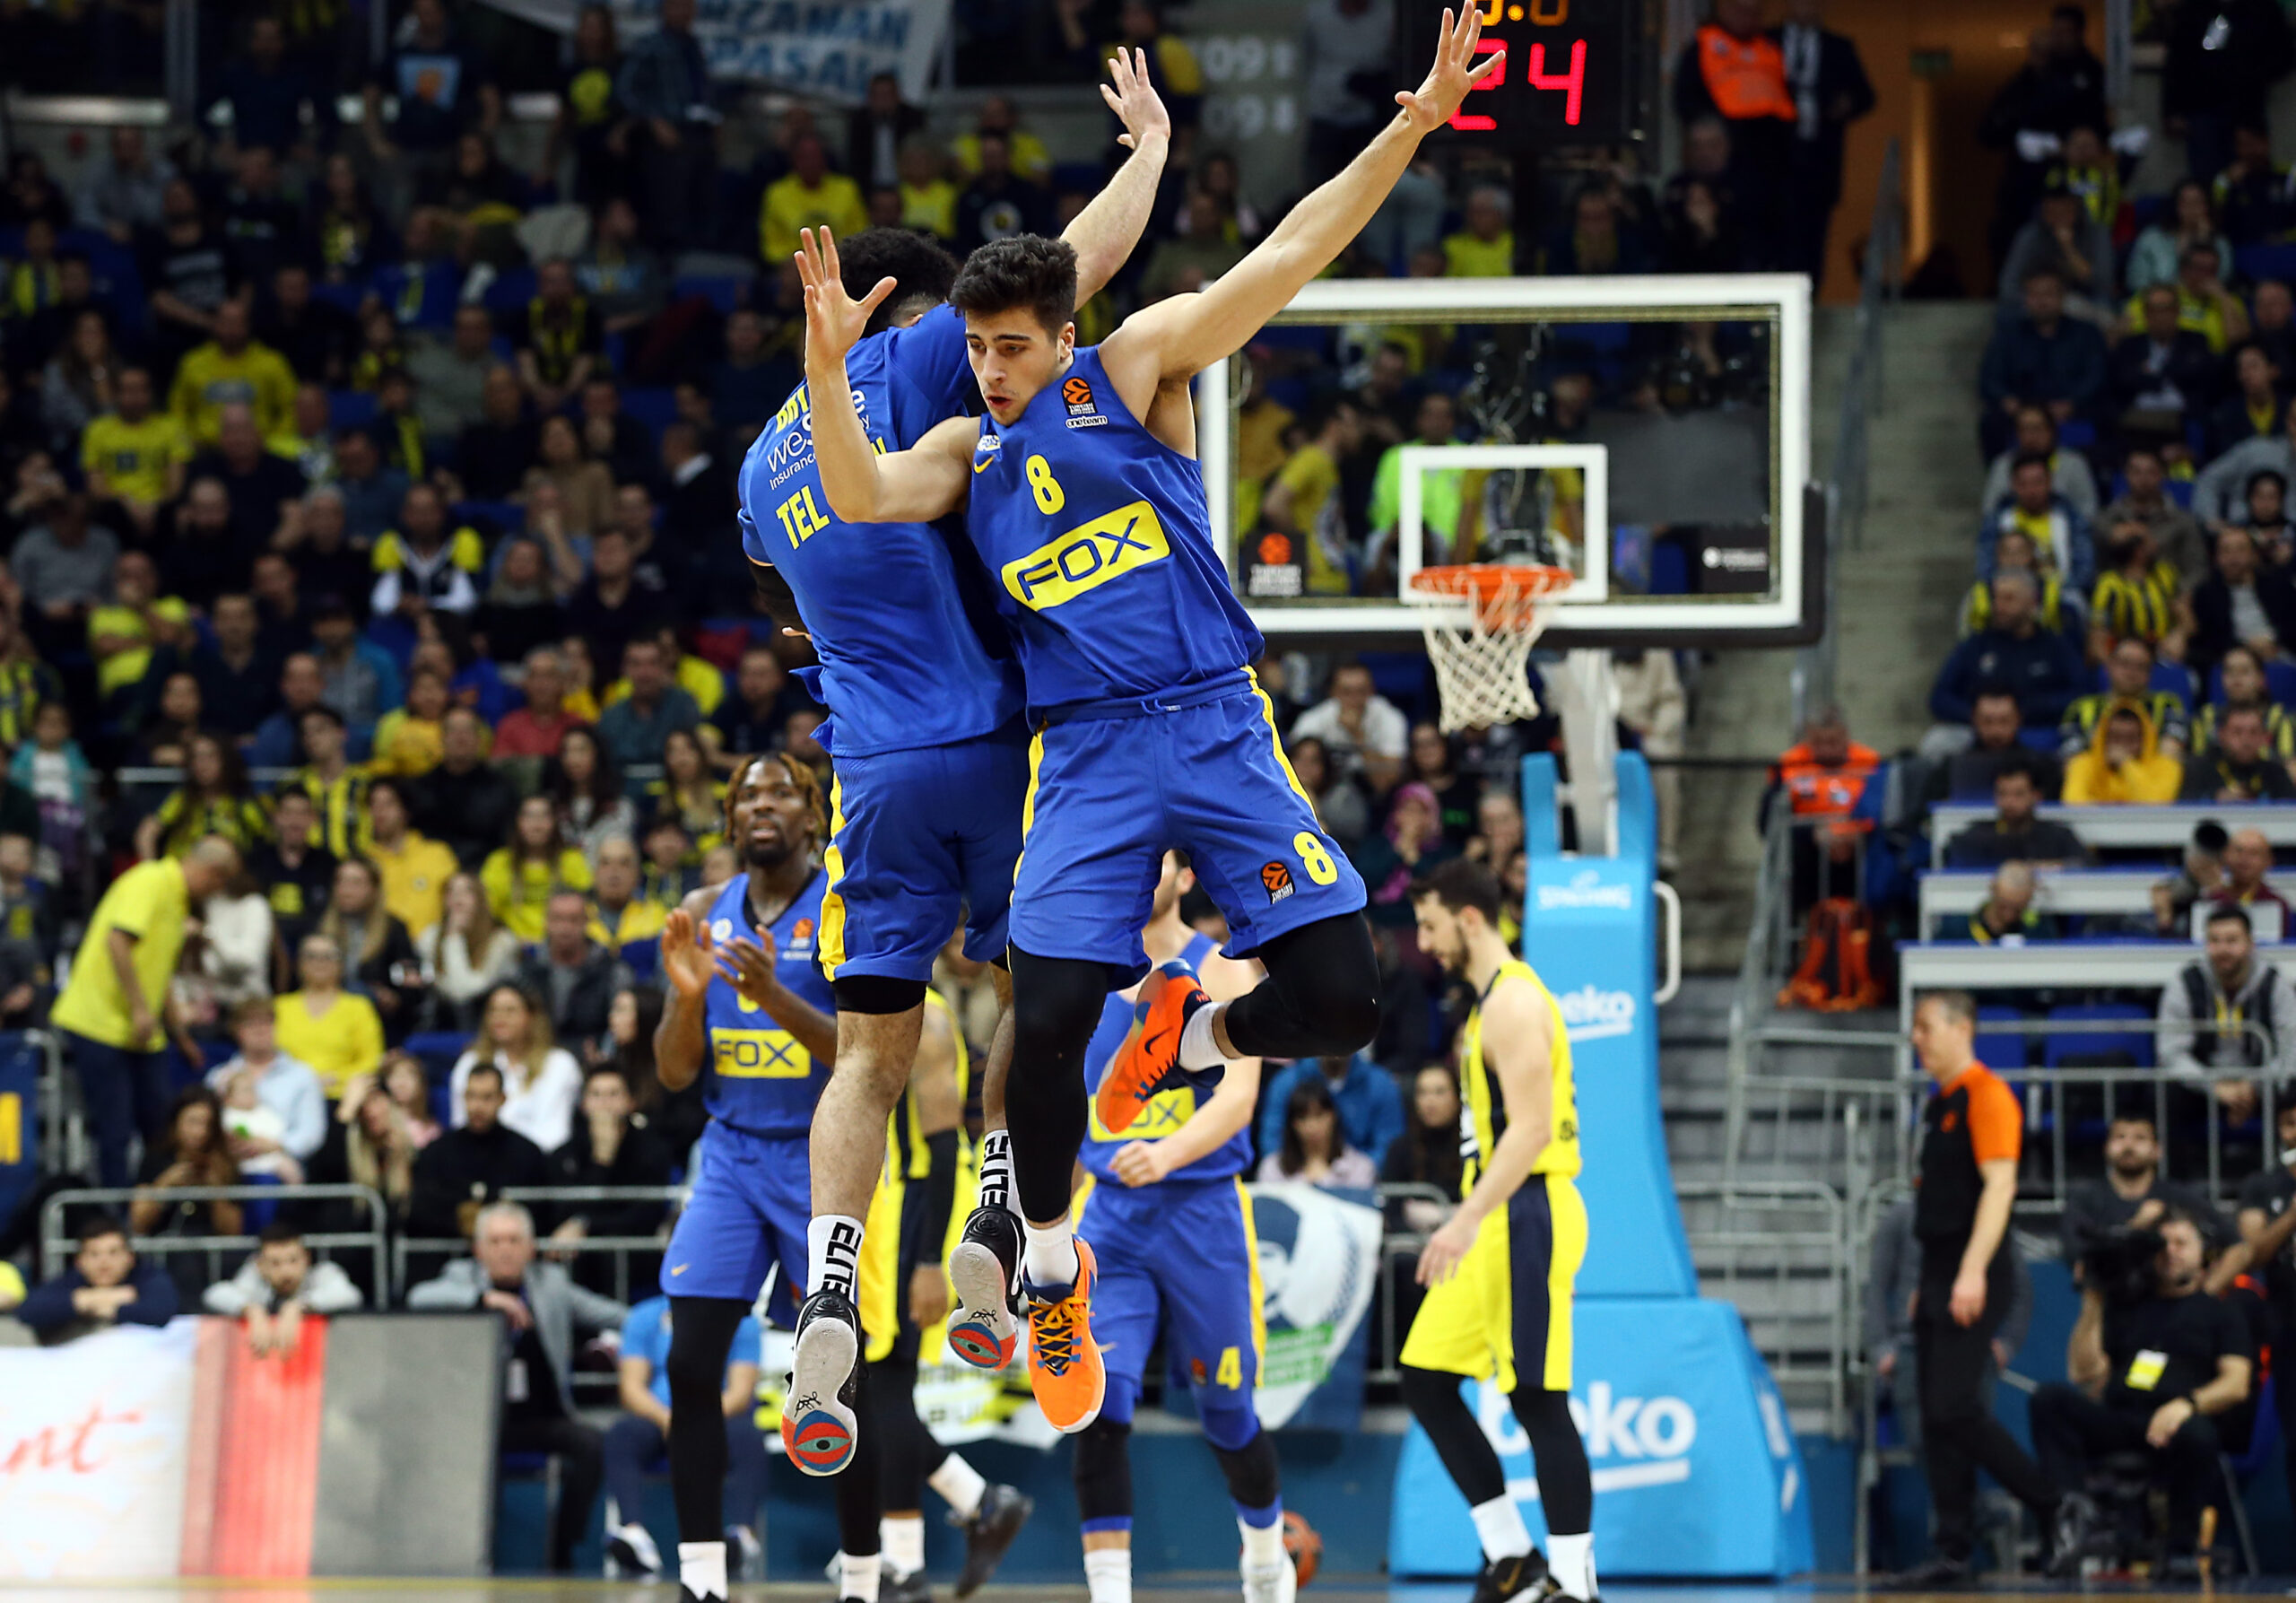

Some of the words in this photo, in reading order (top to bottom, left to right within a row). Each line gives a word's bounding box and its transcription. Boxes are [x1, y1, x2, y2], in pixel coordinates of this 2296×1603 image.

[1447, 39, 1587, 131] 24
[769, 452, 817, 491] Insuranc
[1026, 454, 1065, 516] 8
[776, 484, 831, 551] TEL
[1016, 515, 1153, 602] FOX
[1293, 831, 1339, 886] 8
[1553, 984, 1636, 1024] eko
[718, 1040, 798, 1068] FOX
[1215, 1346, 1243, 1390] 4
[1478, 1381, 1698, 1459] bko
